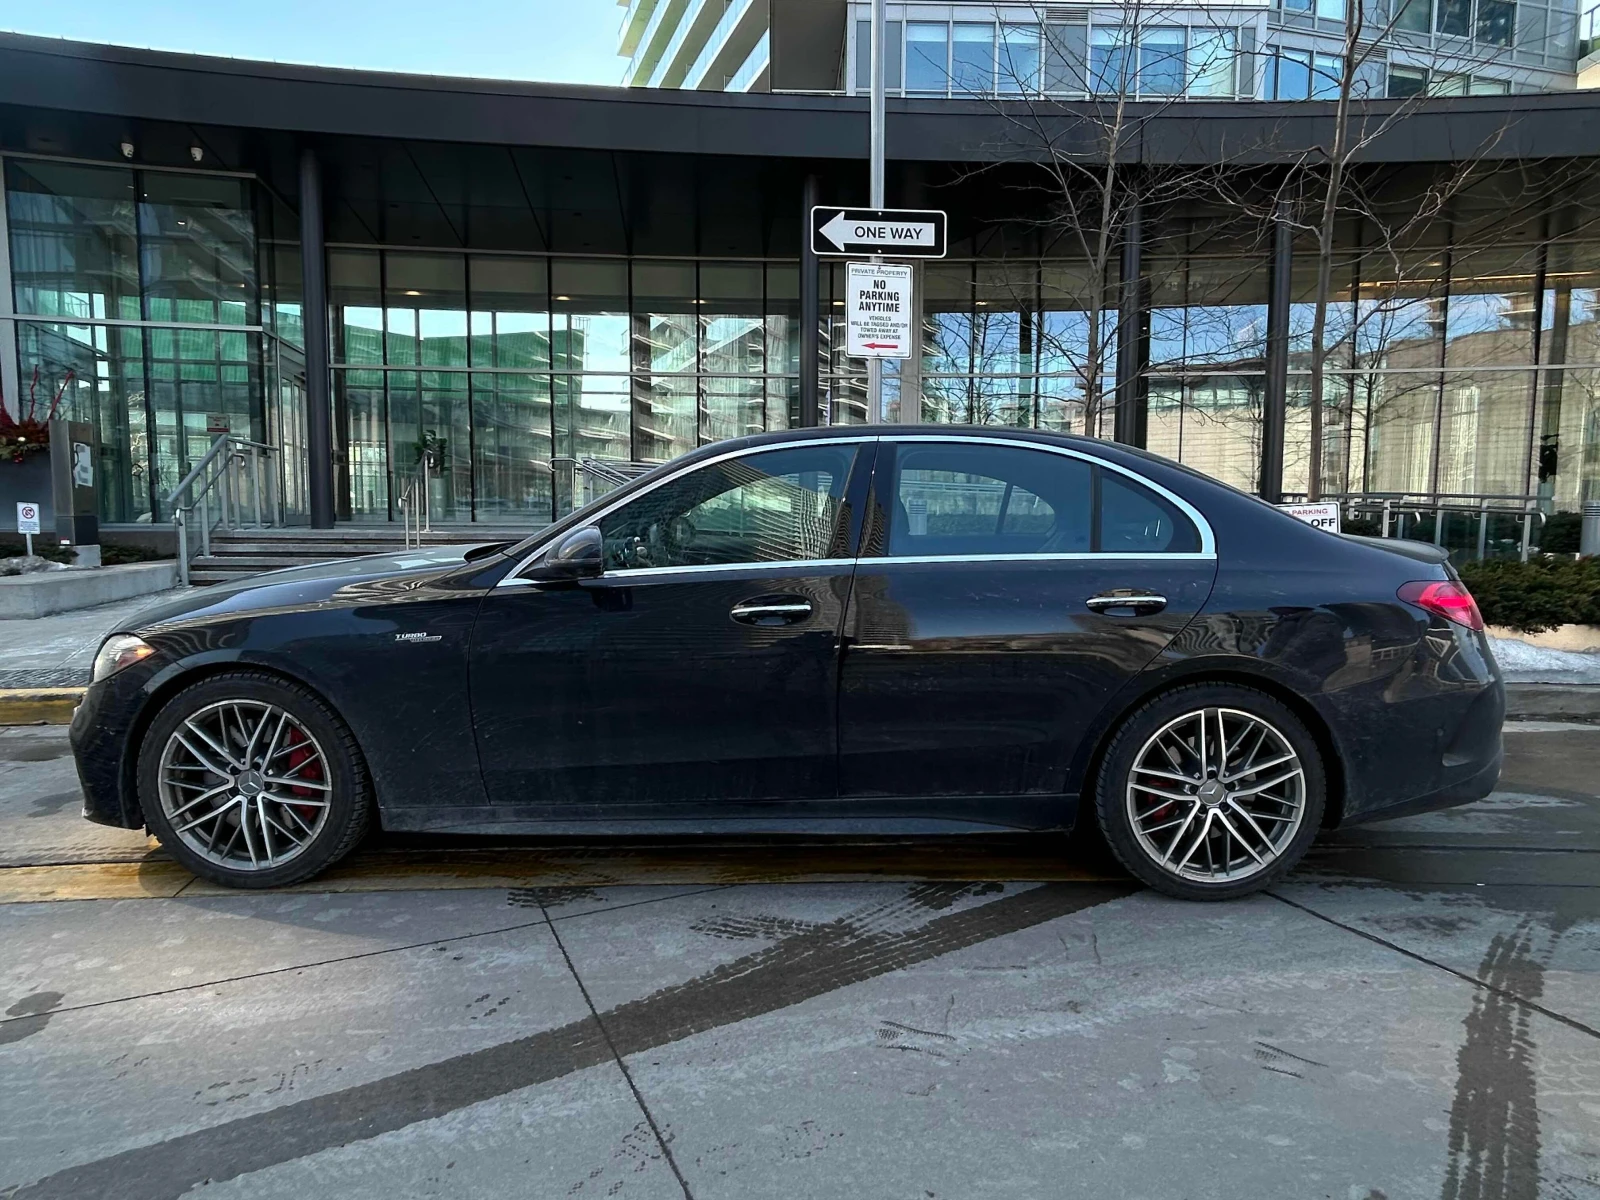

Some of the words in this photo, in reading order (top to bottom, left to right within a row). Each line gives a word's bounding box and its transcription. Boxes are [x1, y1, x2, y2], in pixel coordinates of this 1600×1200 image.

[854, 226, 886, 239] ONE
[890, 227, 923, 240] WAY
[873, 279, 886, 290] NO
[859, 290, 900, 301] PARKING
[858, 301, 900, 313] ANYTIME
[1311, 518, 1336, 528] OFF
